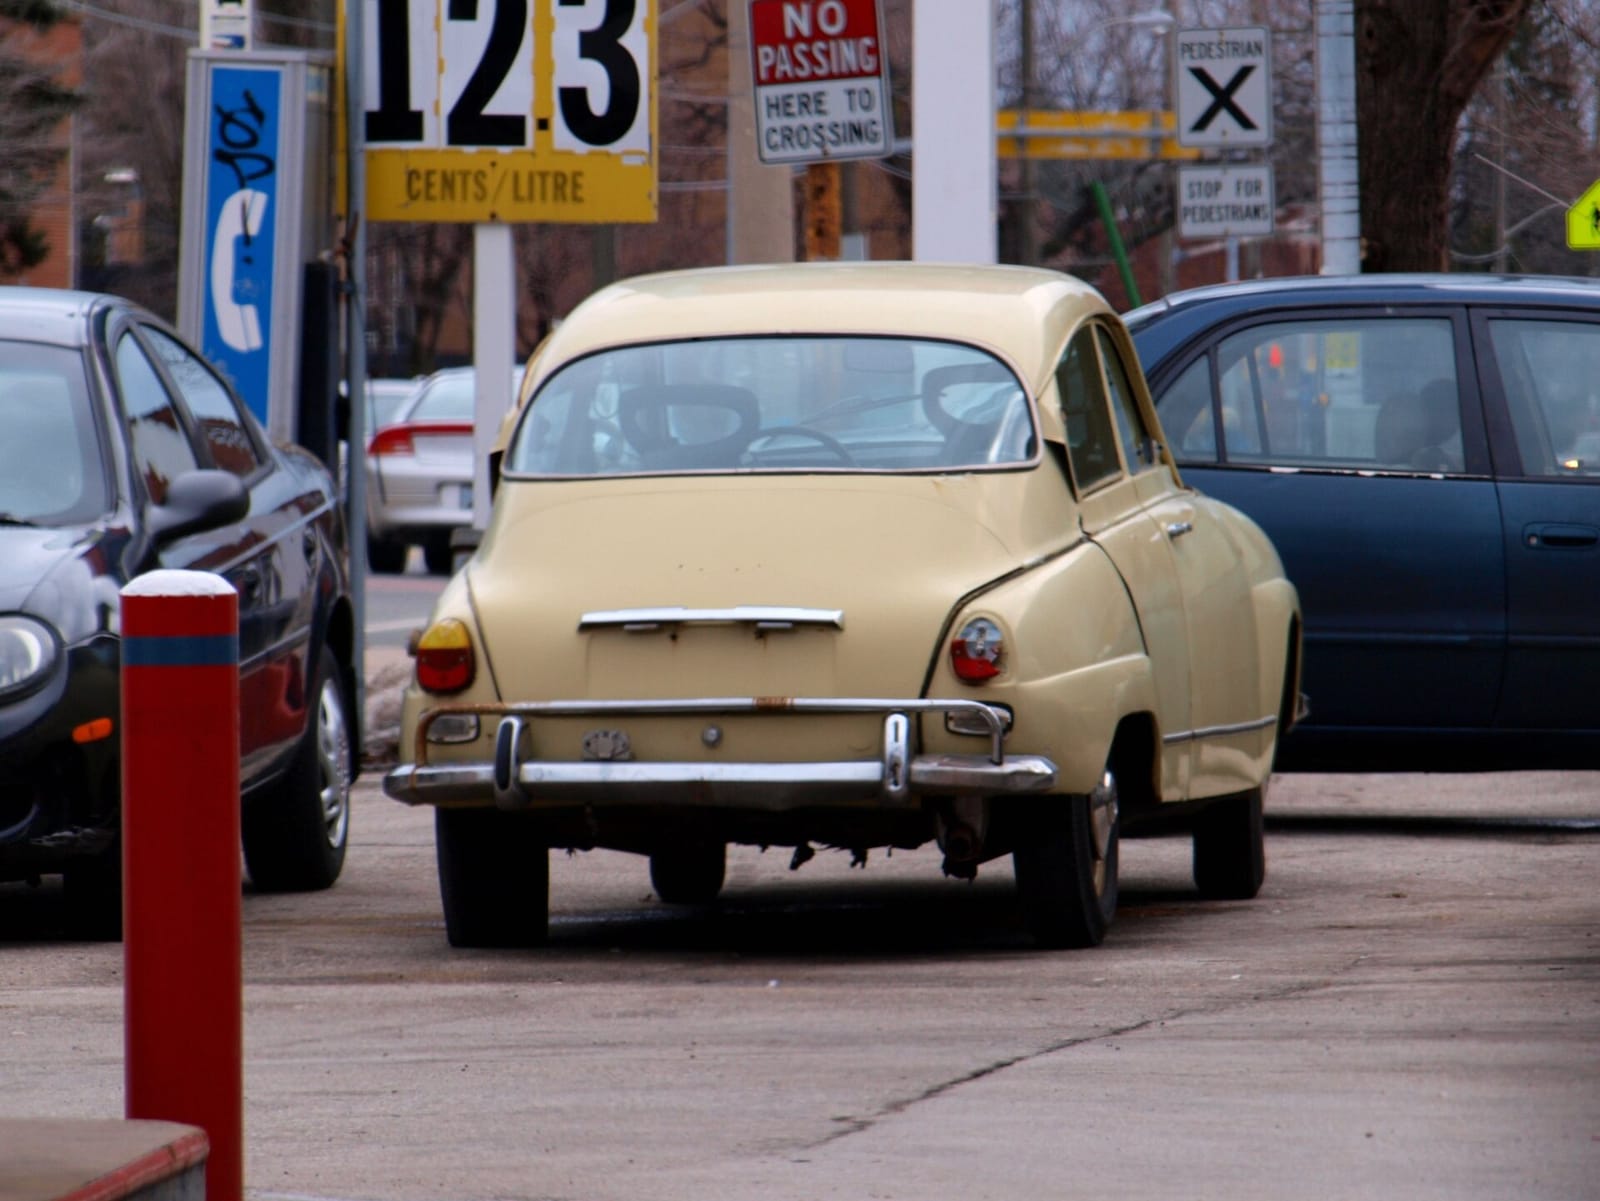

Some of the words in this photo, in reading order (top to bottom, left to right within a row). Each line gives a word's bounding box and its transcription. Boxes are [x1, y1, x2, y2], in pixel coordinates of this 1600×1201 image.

[783, 1, 847, 38] NO
[757, 37, 877, 80] PASSING
[1181, 40, 1263, 59] PEDESTRIAN
[766, 91, 828, 118] HERE
[844, 87, 875, 112] TO
[766, 120, 879, 151] CROSSING
[1188, 180, 1221, 199] STOP
[1236, 178, 1262, 197] FOR
[1183, 203, 1269, 223] PEDESTRIANS
